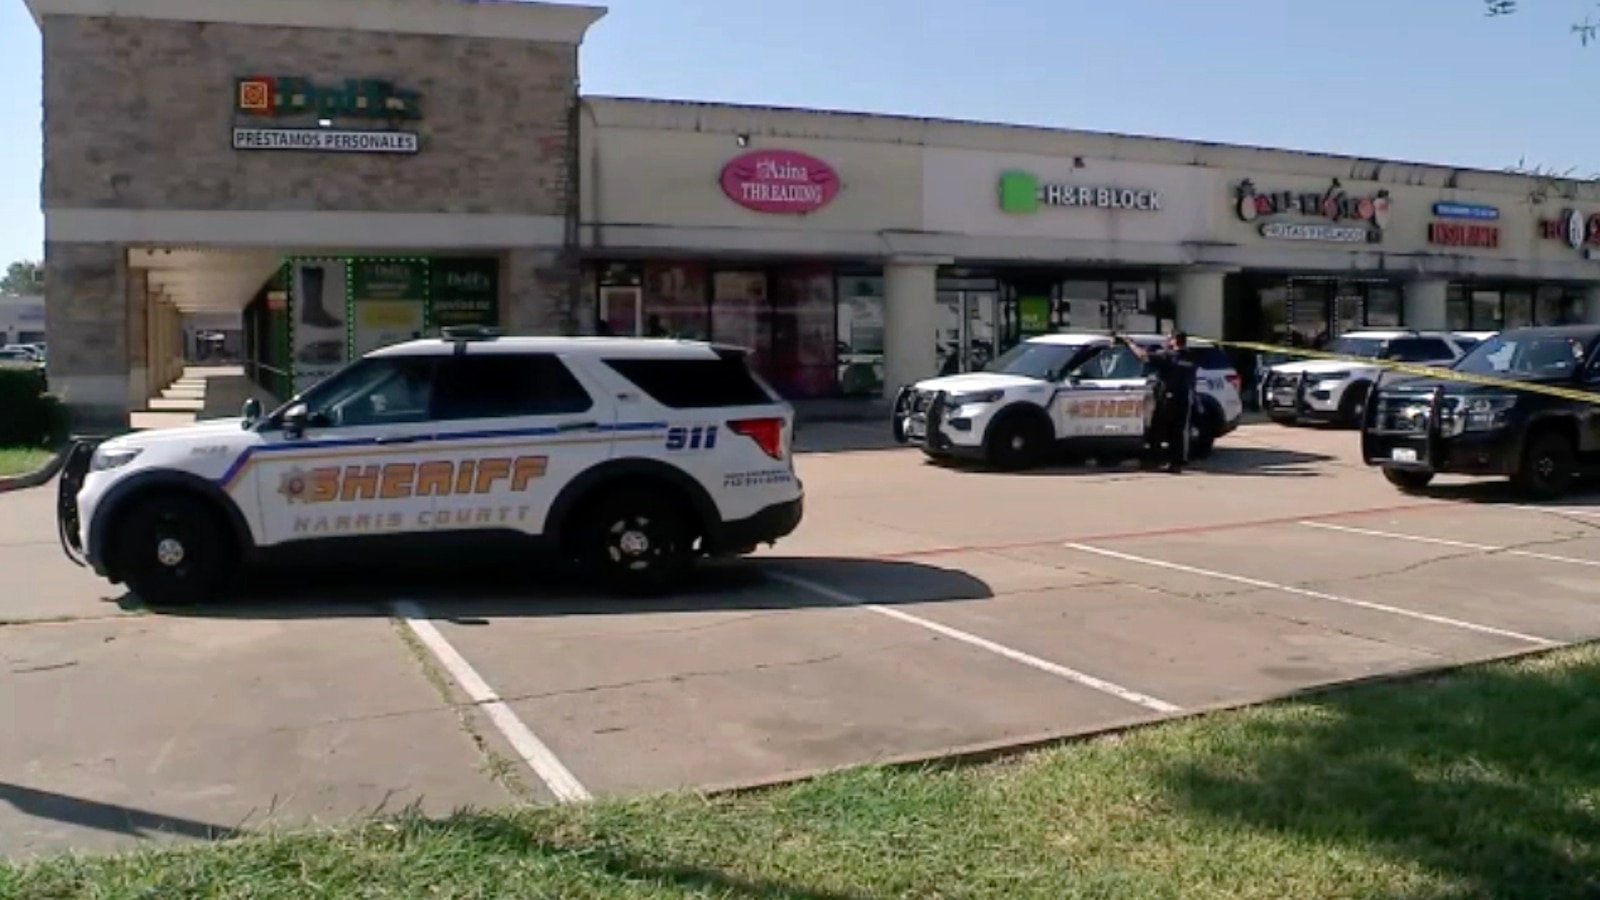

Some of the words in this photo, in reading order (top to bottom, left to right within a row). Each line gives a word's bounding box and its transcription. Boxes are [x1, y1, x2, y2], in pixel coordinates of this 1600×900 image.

[324, 134, 413, 149] PERSONALES
[741, 182, 823, 203] THREADING
[1048, 185, 1092, 206] H&R
[1098, 188, 1162, 210] BLOCK
[666, 426, 718, 450] 911
[311, 455, 548, 502] SHERIFF
[293, 512, 404, 533] HARRIS
